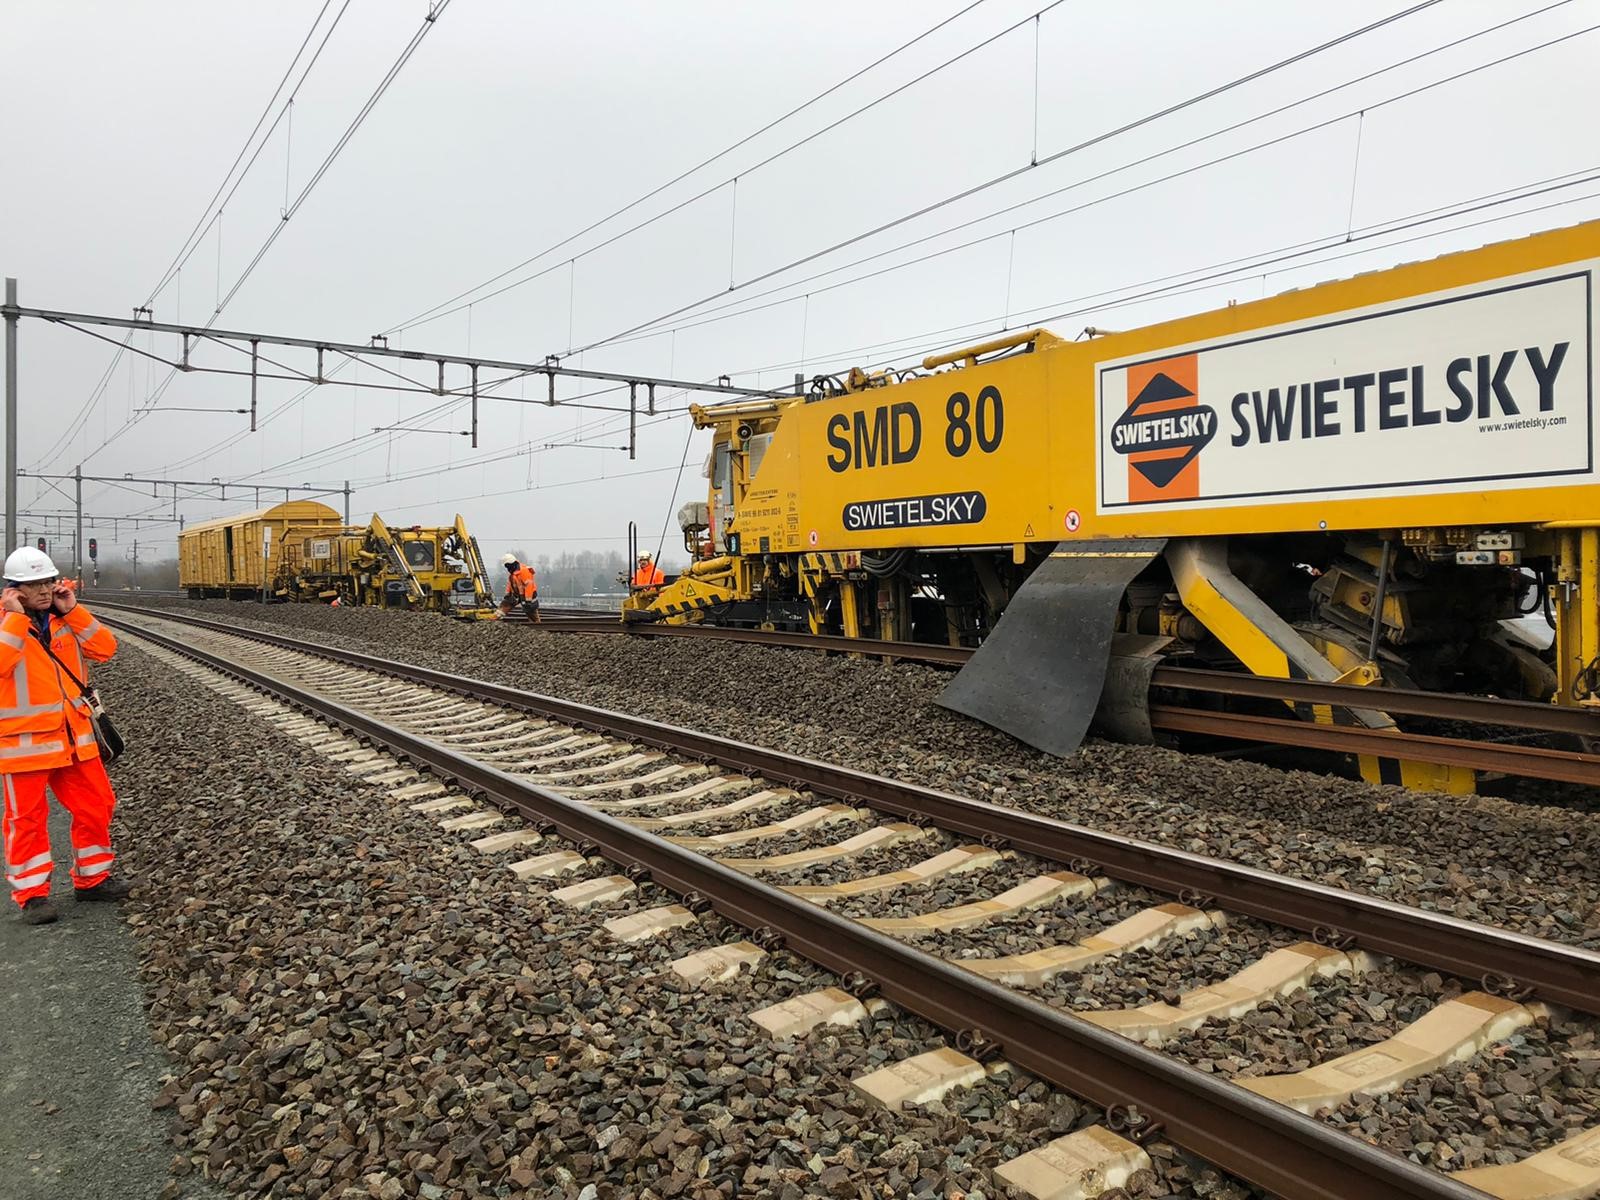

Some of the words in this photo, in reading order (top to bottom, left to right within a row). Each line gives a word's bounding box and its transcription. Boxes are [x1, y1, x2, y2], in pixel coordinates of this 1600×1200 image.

[1231, 341, 1570, 448] SWIETELSKY
[827, 401, 922, 473] SMD
[945, 385, 1004, 458] 80
[1115, 412, 1212, 447] SWIETELSKY
[1478, 416, 1567, 433] www.swietelsky.com
[848, 494, 978, 528] SWIETELSKY
